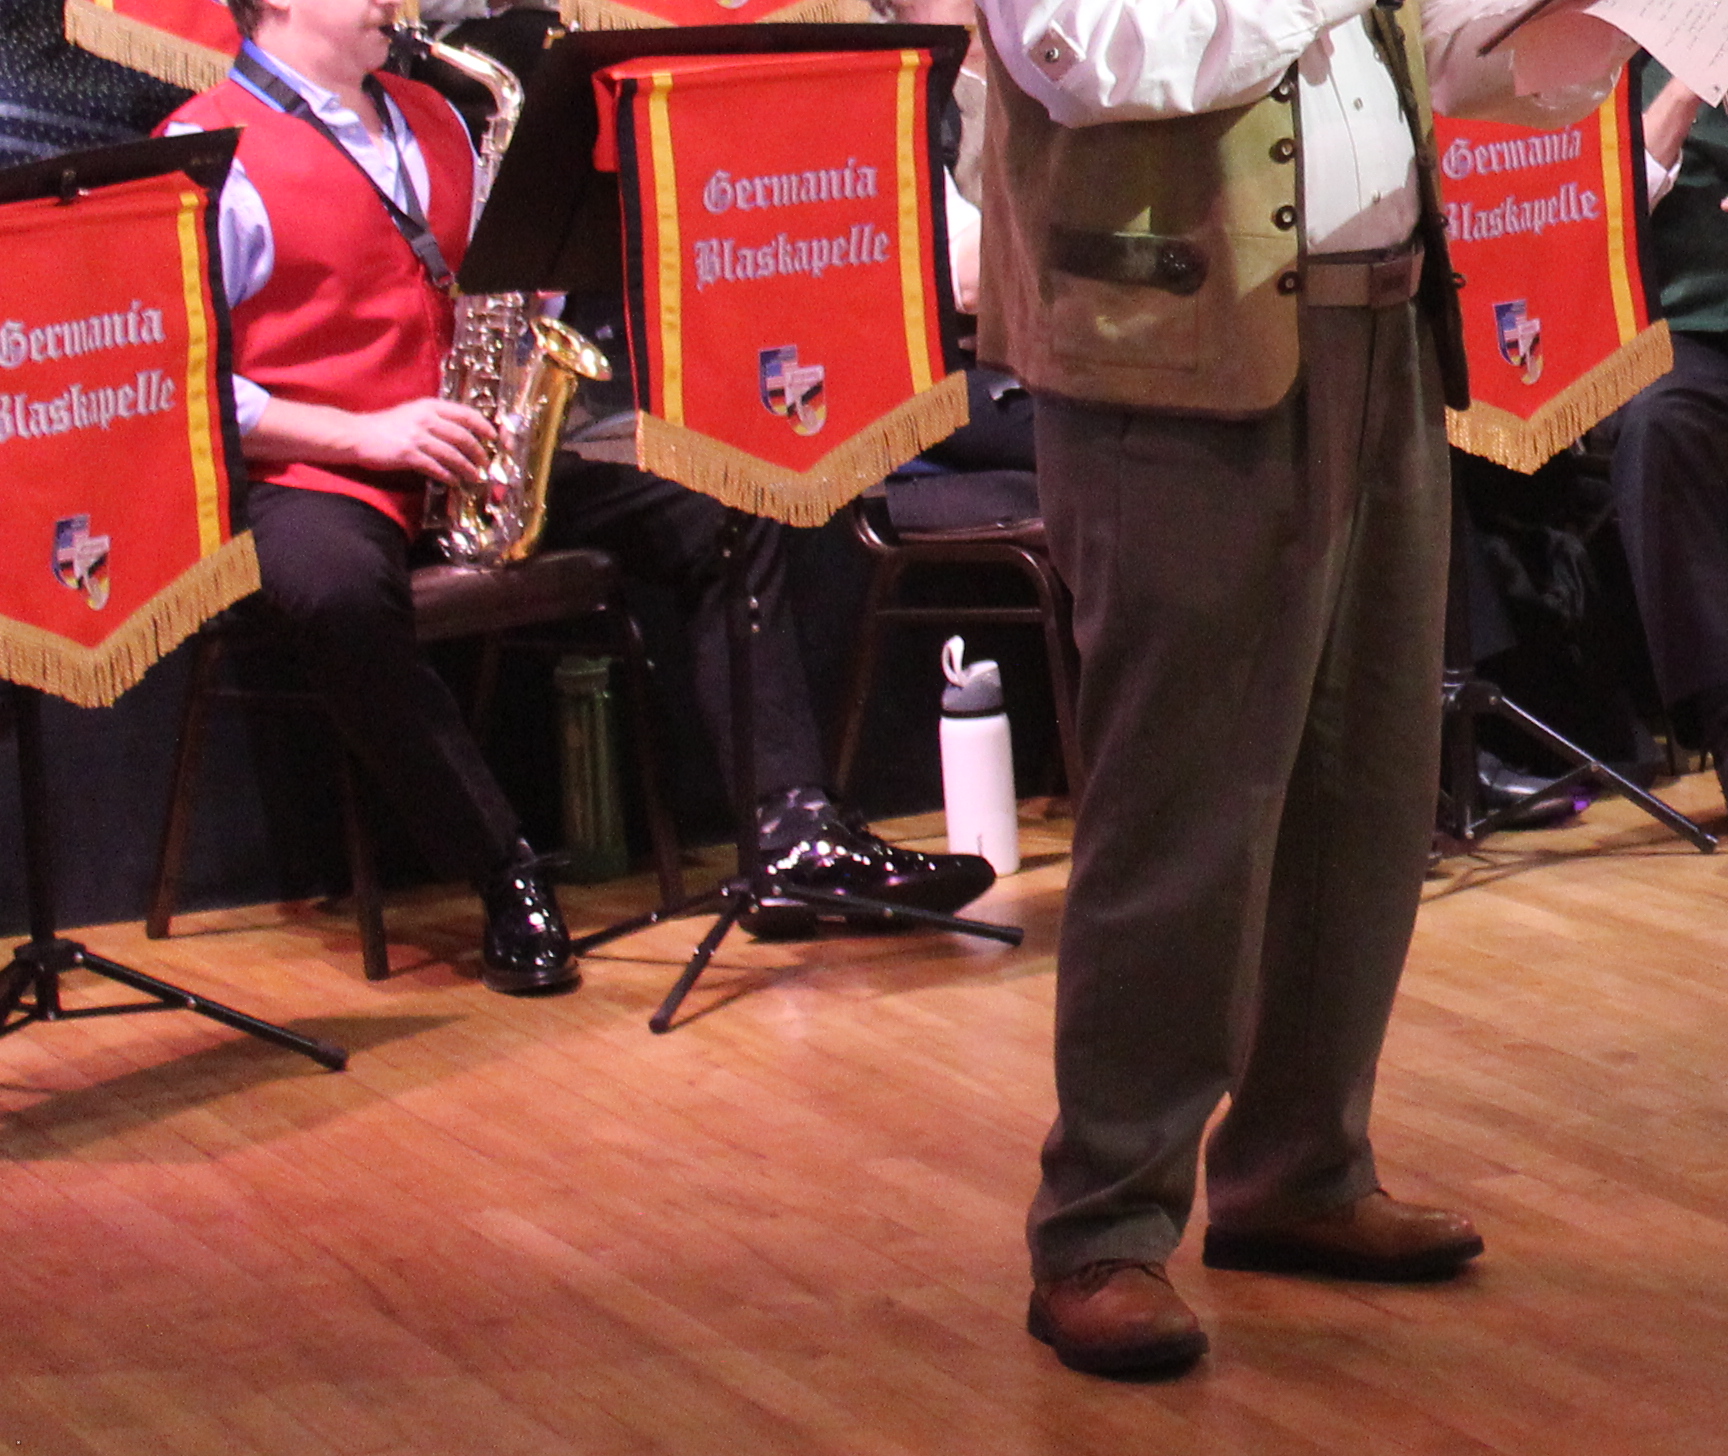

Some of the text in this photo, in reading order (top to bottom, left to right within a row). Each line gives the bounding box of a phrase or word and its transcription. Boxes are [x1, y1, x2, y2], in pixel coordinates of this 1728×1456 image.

[1442, 125, 1582, 180] Germania
[703, 157, 877, 214] Germania
[694, 223, 890, 292] Blaskapelle
[0, 299, 166, 368] Germania
